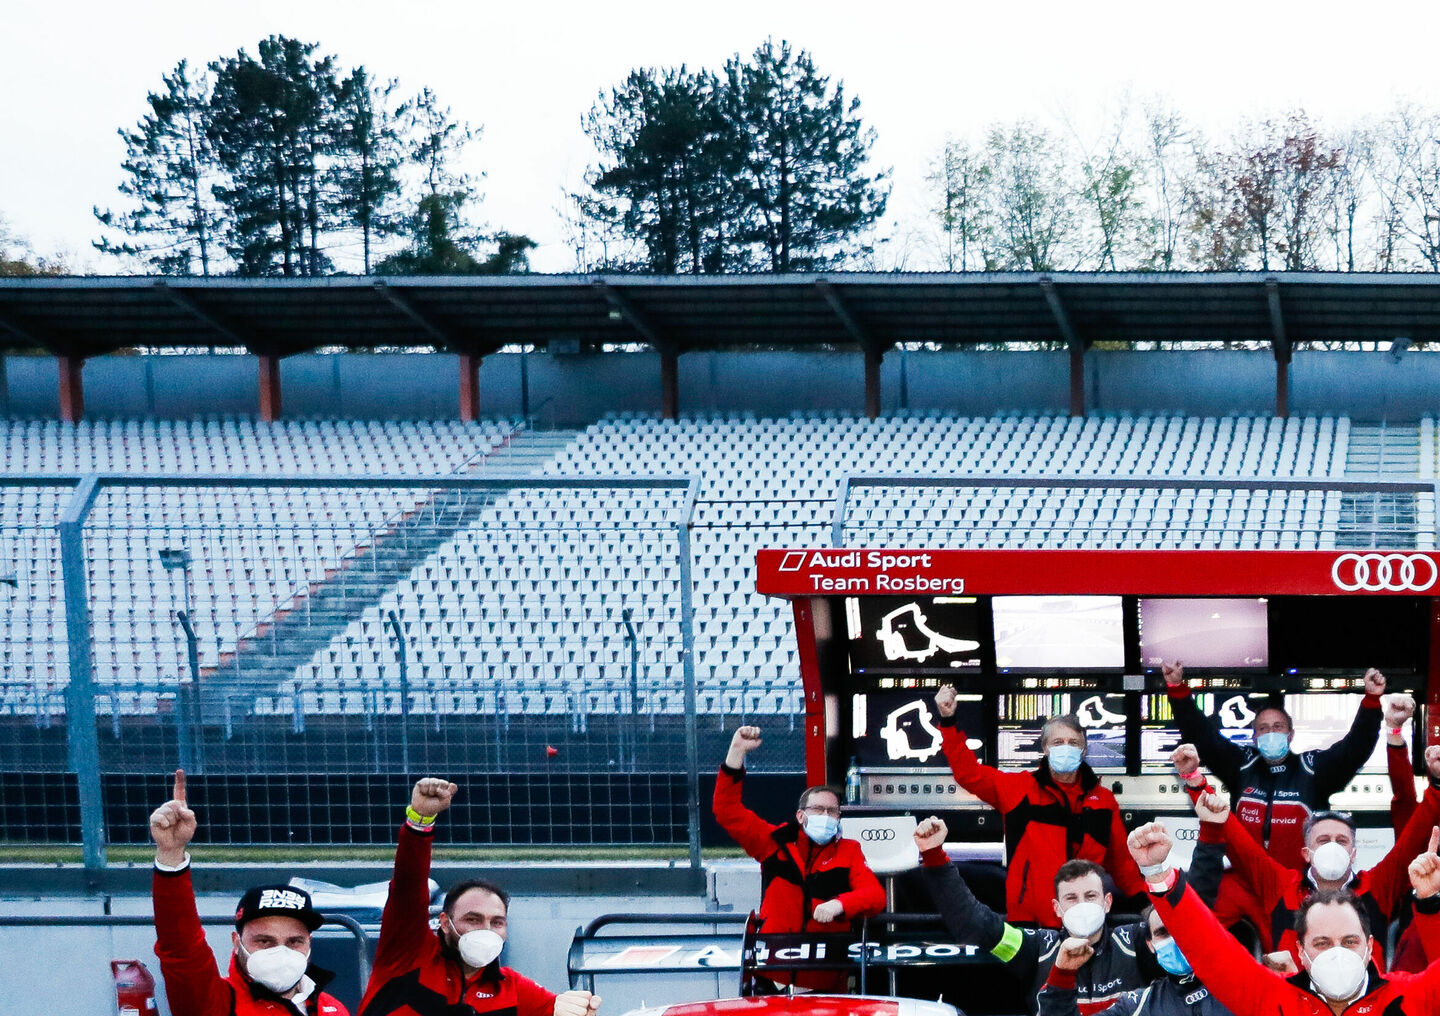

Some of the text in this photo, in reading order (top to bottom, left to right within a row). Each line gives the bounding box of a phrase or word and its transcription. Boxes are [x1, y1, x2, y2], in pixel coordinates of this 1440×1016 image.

[809, 551, 932, 571] Audi Sport
[809, 574, 965, 594] Team Rosberg
[1278, 790, 1300, 798] Sport
[1241, 806, 1259, 816] Audi
[847, 941, 980, 961] Spor
[1097, 978, 1123, 993] Sport
